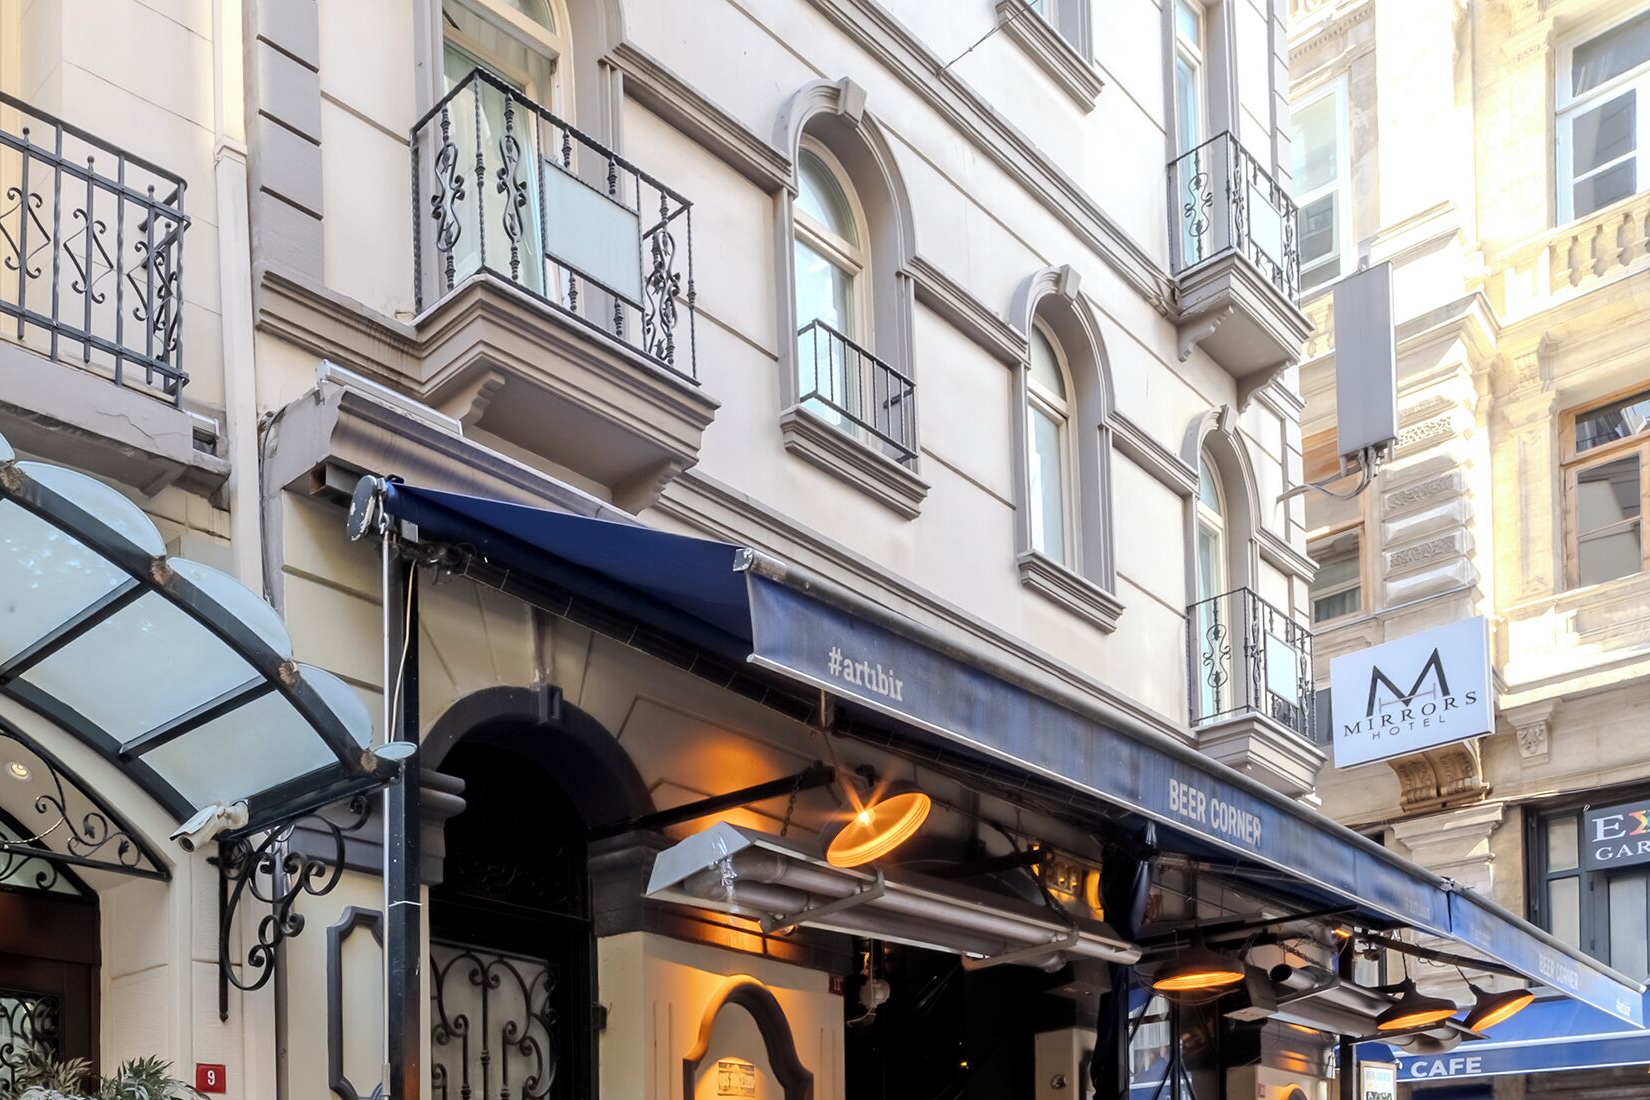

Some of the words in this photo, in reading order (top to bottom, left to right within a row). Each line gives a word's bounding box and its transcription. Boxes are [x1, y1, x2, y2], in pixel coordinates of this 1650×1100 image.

[1343, 691, 1477, 737] MIRRORS
[1372, 715, 1445, 740] HOTEL
[1170, 778, 1206, 824] BEER
[1211, 798, 1261, 847] CORNER
[207, 1069, 216, 1086] 9
[1411, 1056, 1482, 1078] CAFE
